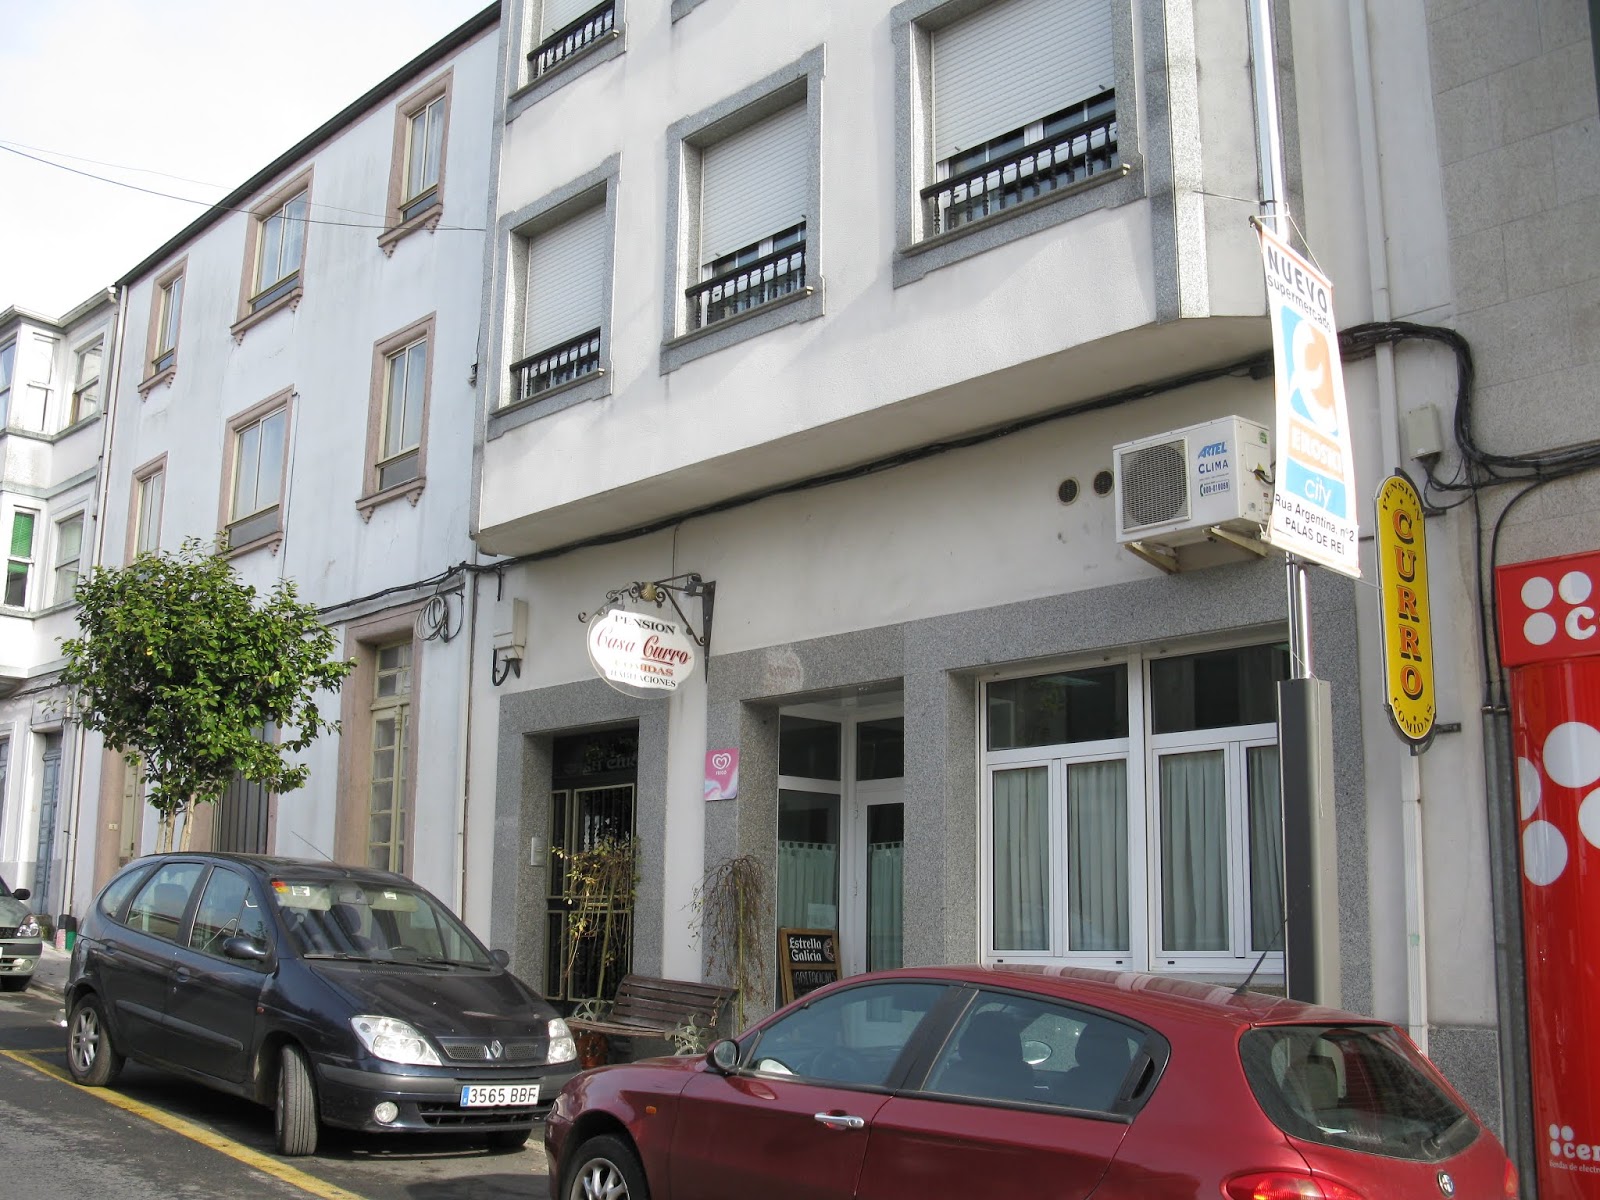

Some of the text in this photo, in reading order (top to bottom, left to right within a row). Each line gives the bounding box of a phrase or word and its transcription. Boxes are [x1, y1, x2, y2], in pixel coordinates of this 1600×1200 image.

[1268, 245, 1327, 314] NUEVO
[1197, 441, 1228, 459] ARTEL
[1198, 459, 1229, 474] CLIMA
[1275, 493, 1292, 512] Rua
[1304, 476, 1331, 510] city
[1382, 481, 1420, 521] PENSION
[1285, 516, 1345, 556] PALAS DE REI
[1392, 508, 1424, 701] CURRO
[615, 615, 676, 635] PENSION
[597, 626, 691, 665] Casa Curro
[1393, 697, 1432, 734] COMIDAS
[789, 937, 822, 949] Estrella
[791, 949, 822, 961] Galicia
[469, 1088, 505, 1103] 3565
[510, 1087, 536, 1103] BBF
[1569, 1162, 1578, 1171] de
